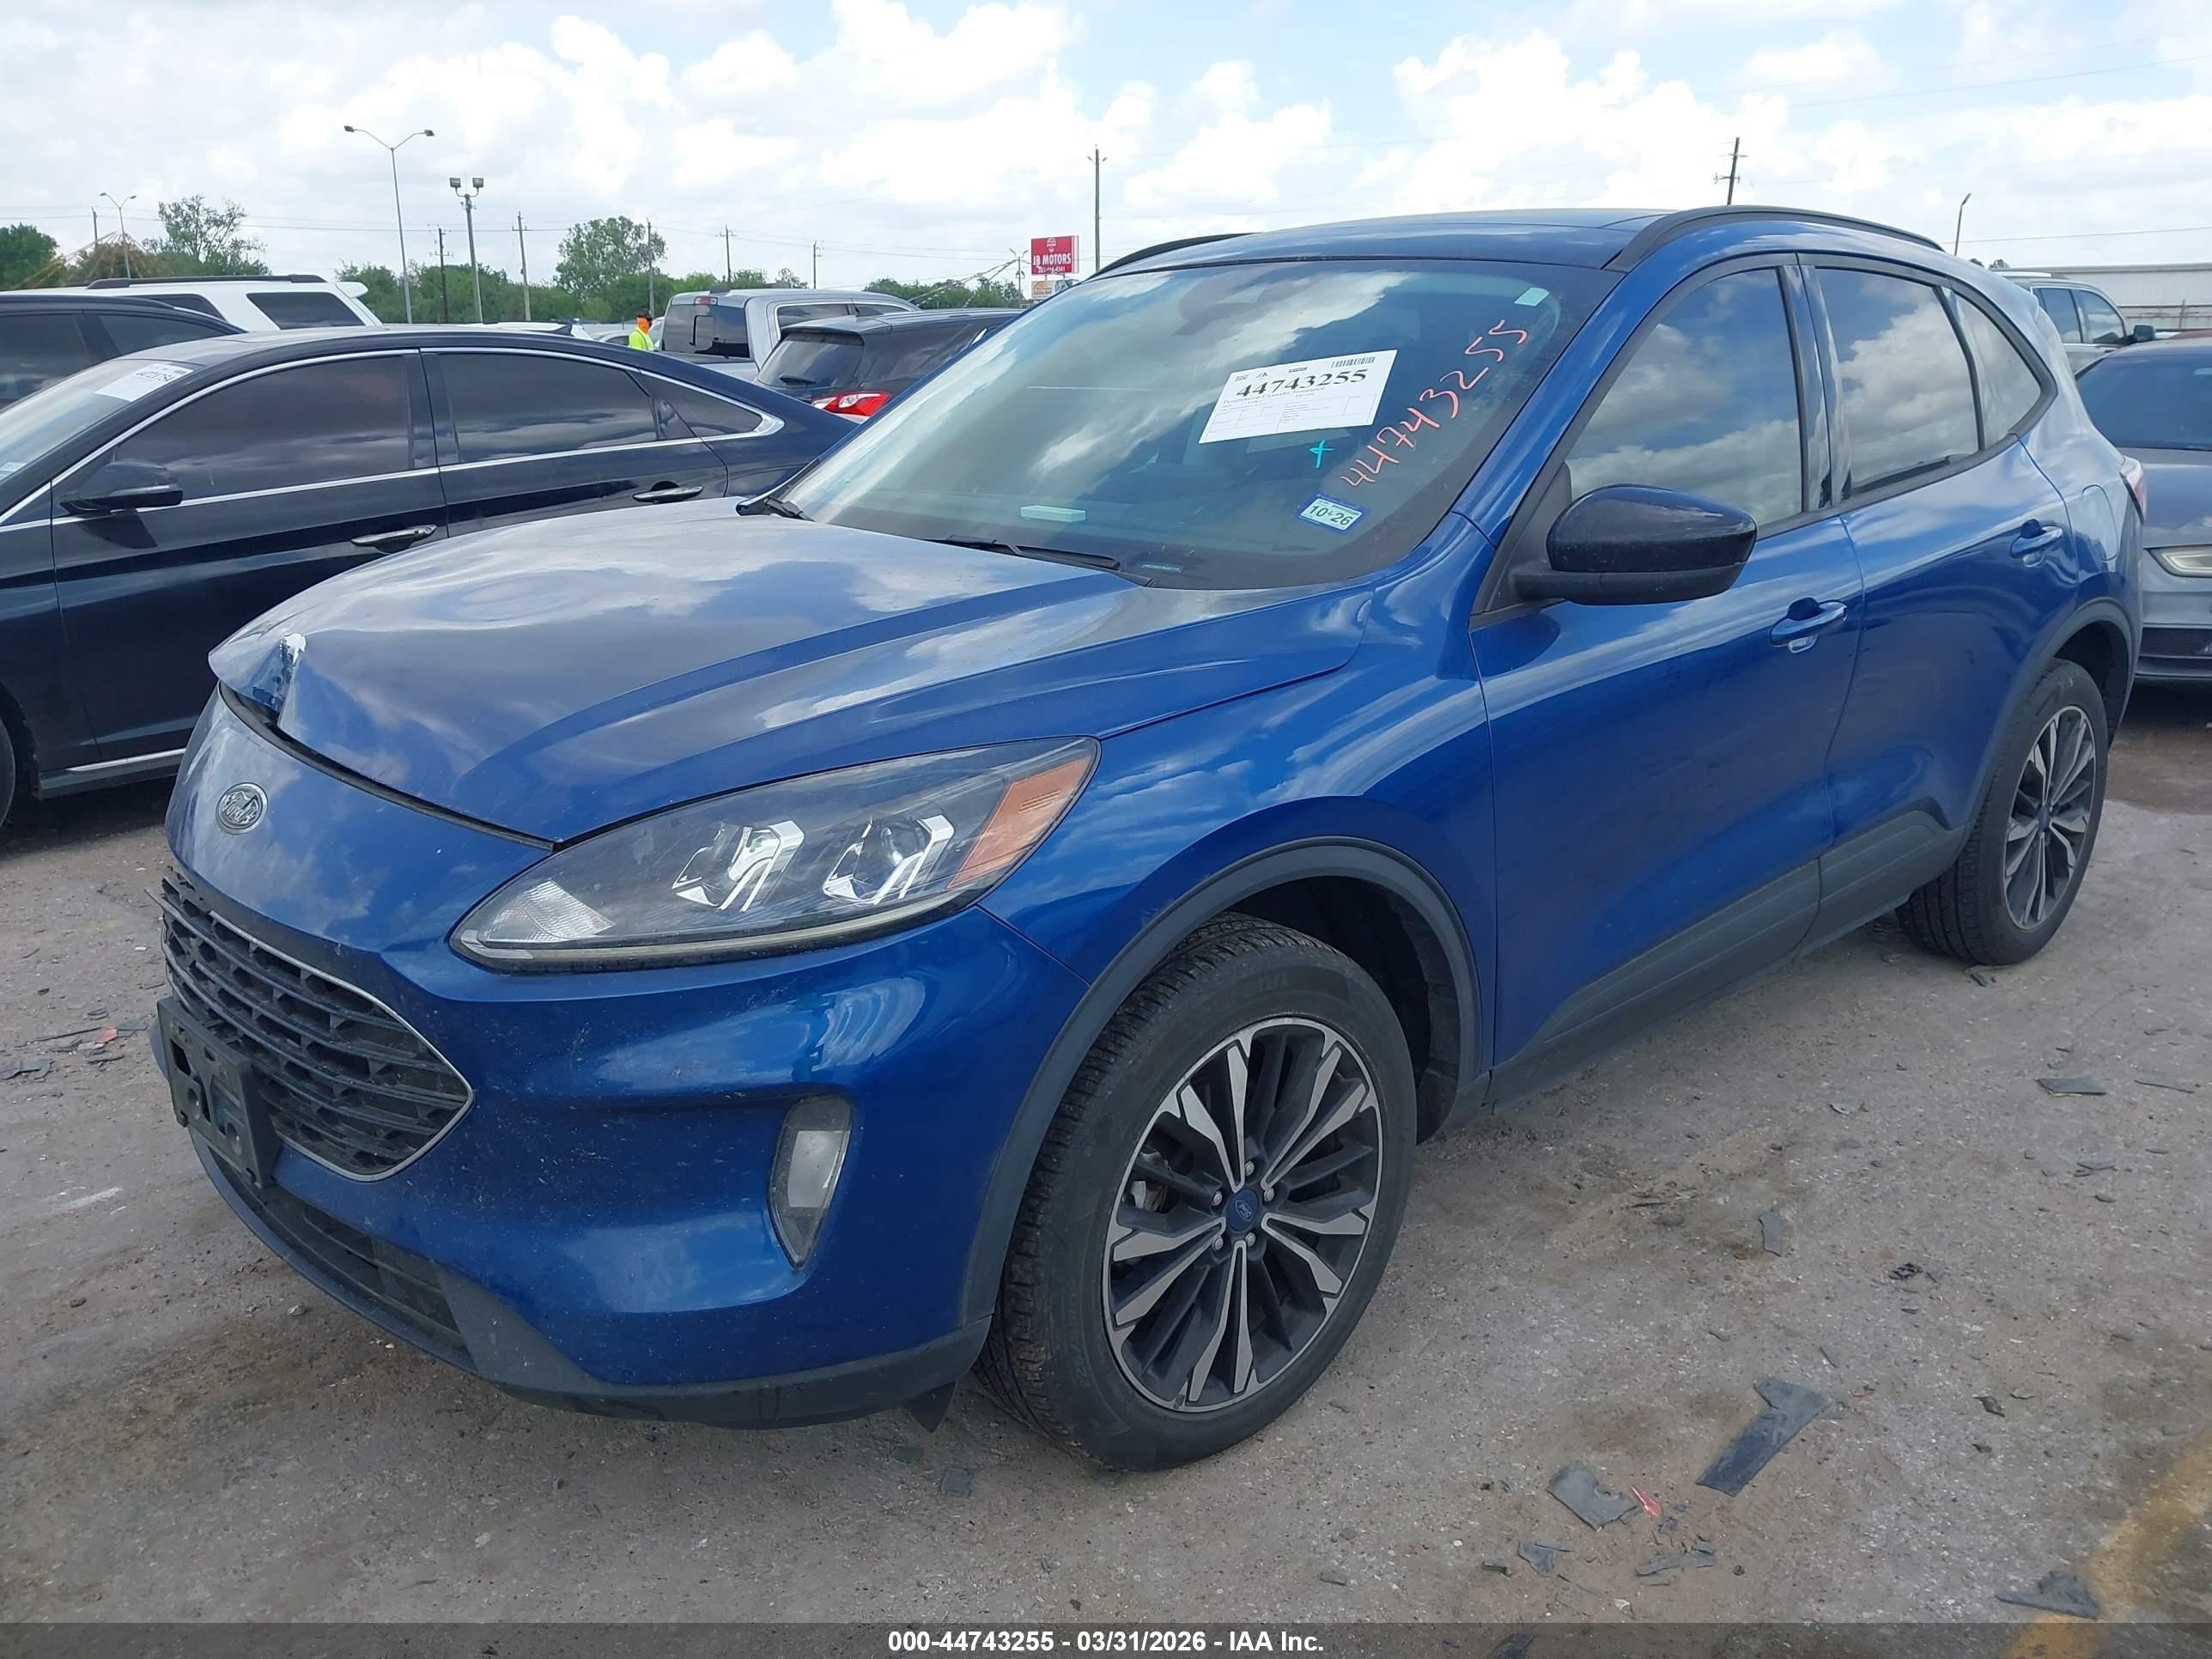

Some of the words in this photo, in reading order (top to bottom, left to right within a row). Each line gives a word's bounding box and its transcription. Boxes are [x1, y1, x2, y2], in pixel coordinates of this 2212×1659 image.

[1033, 254, 1041, 265] JB
[1042, 252, 1072, 265] MOTORS
[1236, 368, 1369, 397] 44743255
[1340, 319, 1528, 487] 44743255
[1310, 505, 1328, 517] 10
[1330, 512, 1353, 526] 26
